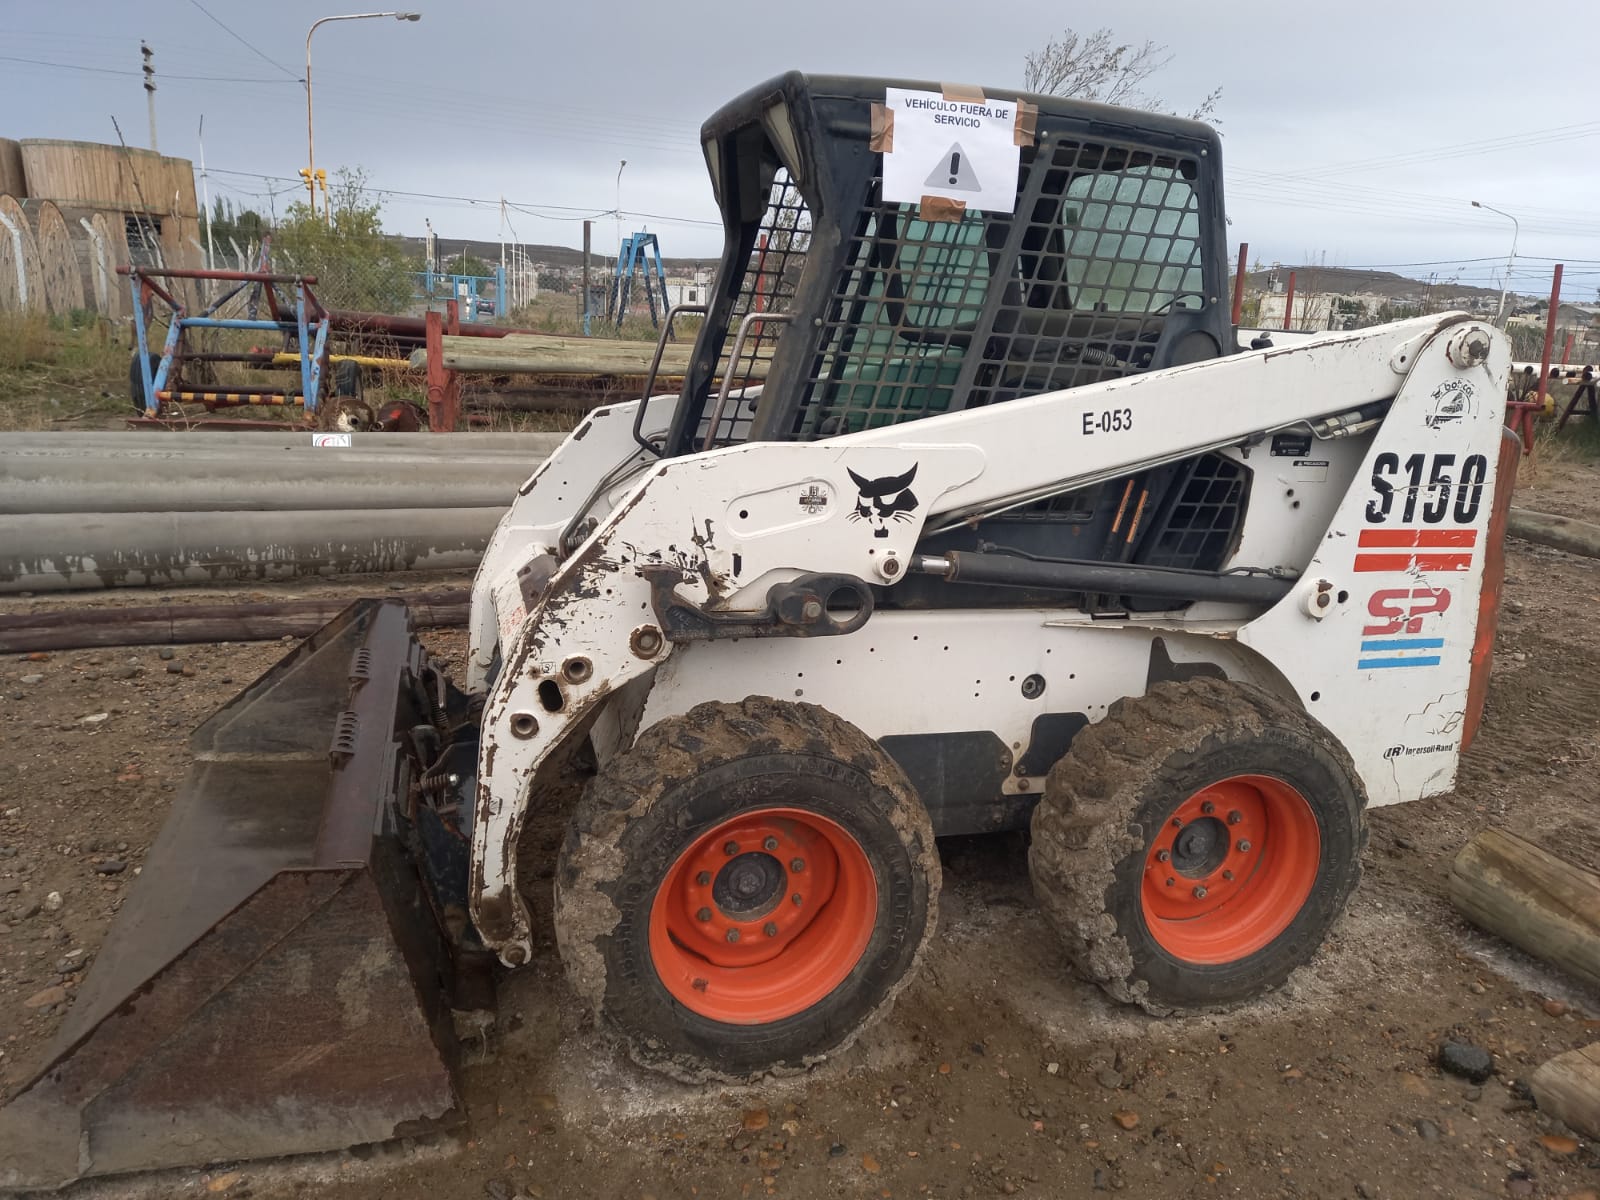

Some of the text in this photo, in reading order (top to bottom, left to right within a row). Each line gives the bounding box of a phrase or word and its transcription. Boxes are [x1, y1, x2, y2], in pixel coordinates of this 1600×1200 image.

[905, 98, 1008, 119] VEHÍCULO FUERA DE
[934, 114, 981, 128] SERVICIO
[1083, 408, 1132, 435] E-053
[1365, 452, 1487, 524] S150
[1362, 587, 1451, 636] SP
